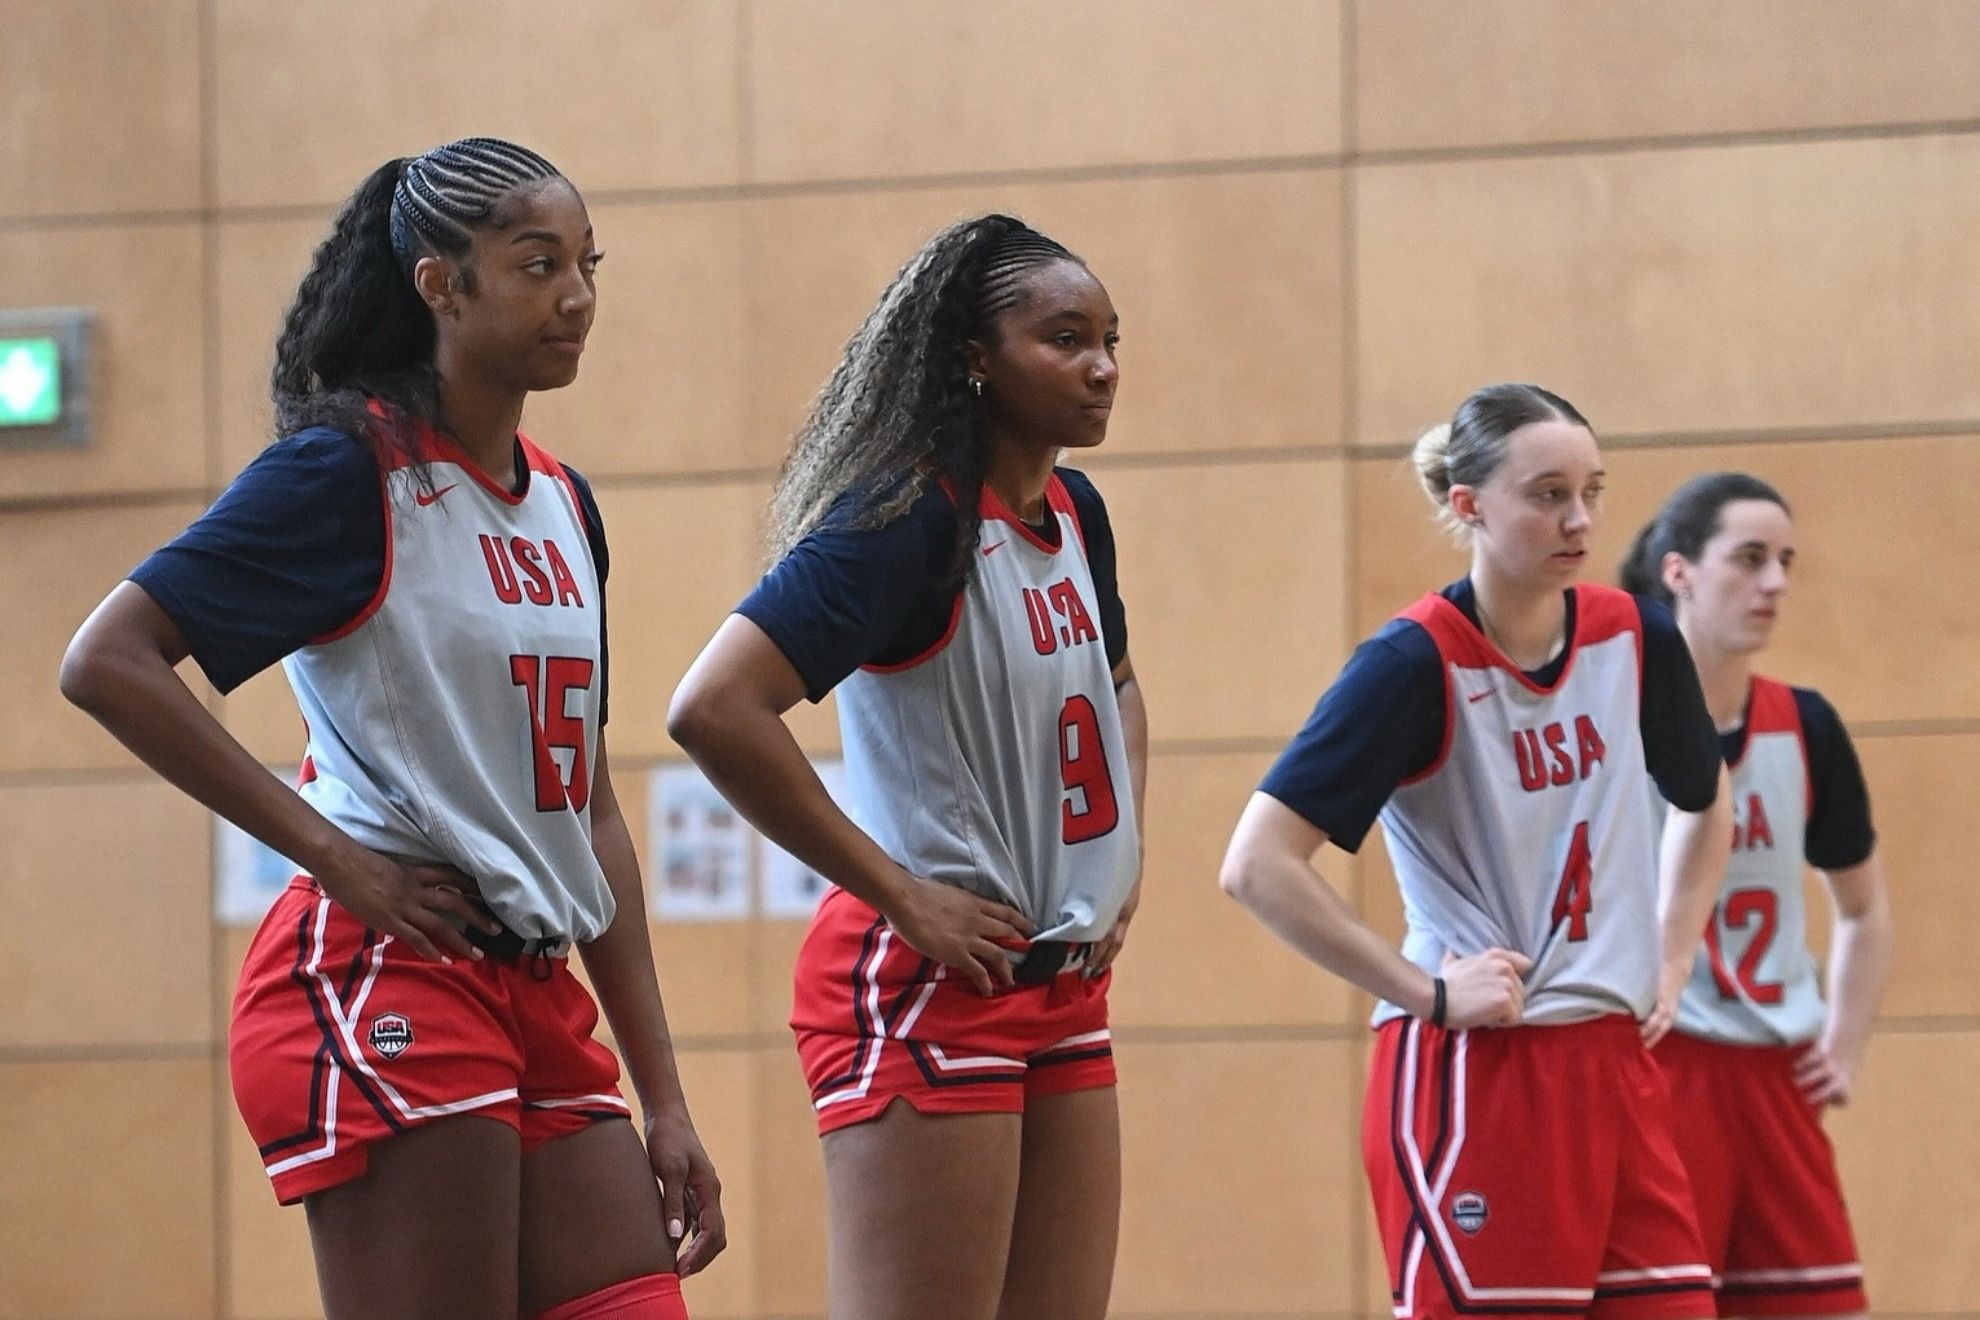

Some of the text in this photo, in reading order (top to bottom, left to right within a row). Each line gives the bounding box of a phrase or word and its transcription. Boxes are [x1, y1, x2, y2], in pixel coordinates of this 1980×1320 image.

[478, 534, 585, 608] USA
[510, 654, 594, 814] 15
[1058, 694, 1119, 845] 9
[1513, 714, 1606, 792] USA
[1551, 820, 1592, 942] 4
[377, 1020, 405, 1034] USA
